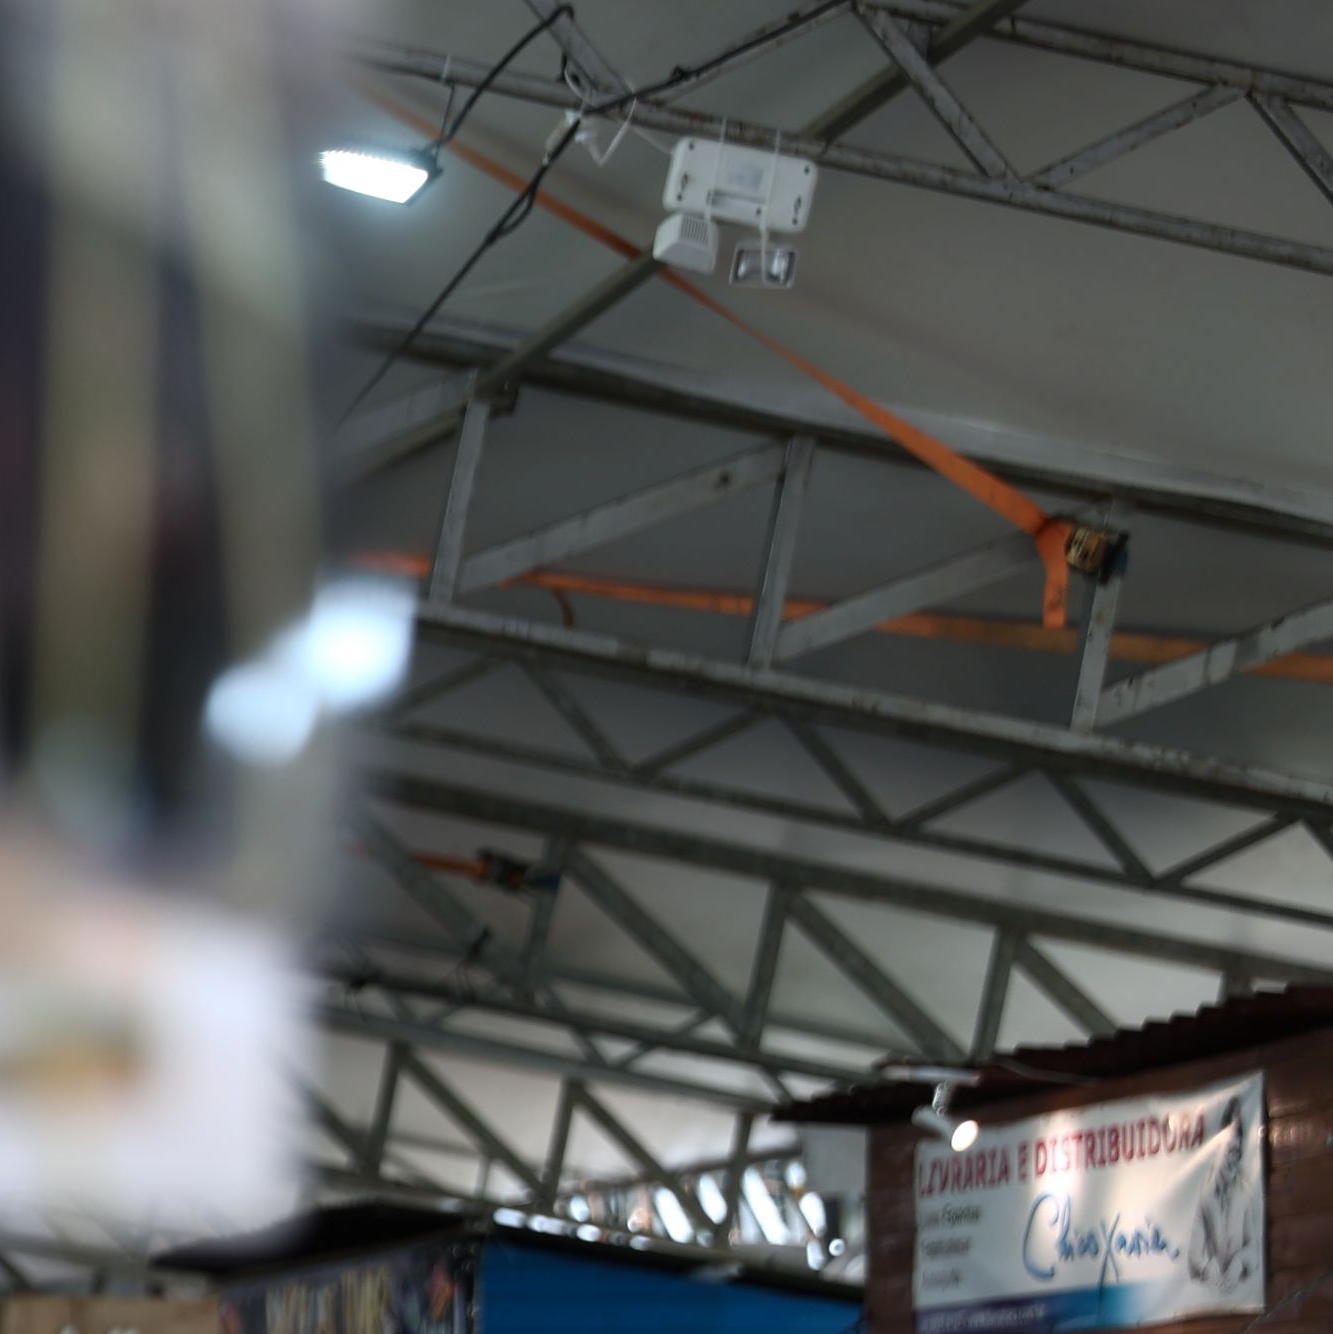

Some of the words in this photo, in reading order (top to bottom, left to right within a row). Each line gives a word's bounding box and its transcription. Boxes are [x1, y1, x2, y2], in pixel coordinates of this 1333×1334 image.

[917, 1150, 1010, 1197] LIVRARIA
[1017, 1144, 1030, 1182] E
[1033, 1111, 1206, 1177] DISTRIBUIDORA
